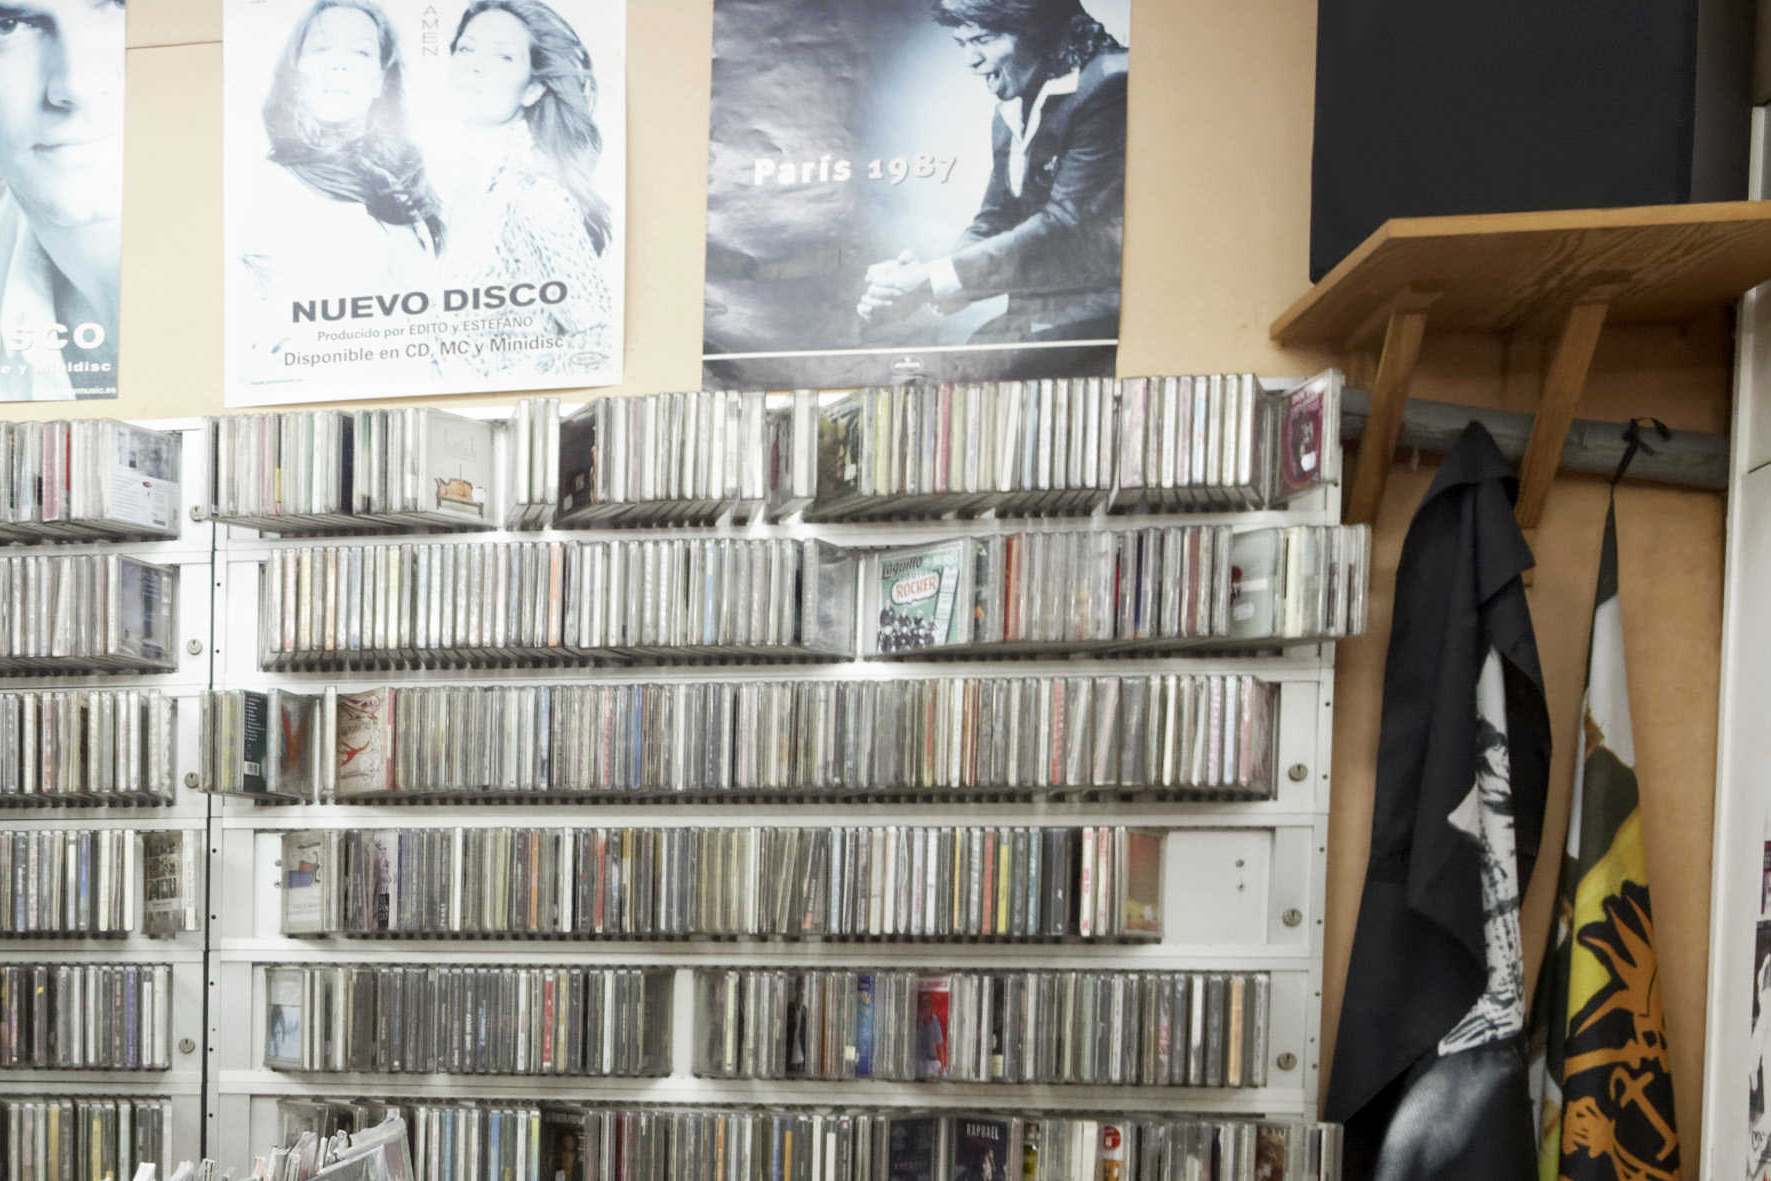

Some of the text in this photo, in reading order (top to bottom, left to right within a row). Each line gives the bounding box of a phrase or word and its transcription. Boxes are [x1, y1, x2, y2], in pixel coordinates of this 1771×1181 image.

[868, 152, 958, 186] 1987
[292, 281, 569, 323] NUEVO DISCO
[317, 327, 381, 342] Producido
[384, 327, 405, 339] por
[409, 321, 449, 336] EDITO
[284, 334, 565, 367] Disponible en CD, MC y Minidisc
